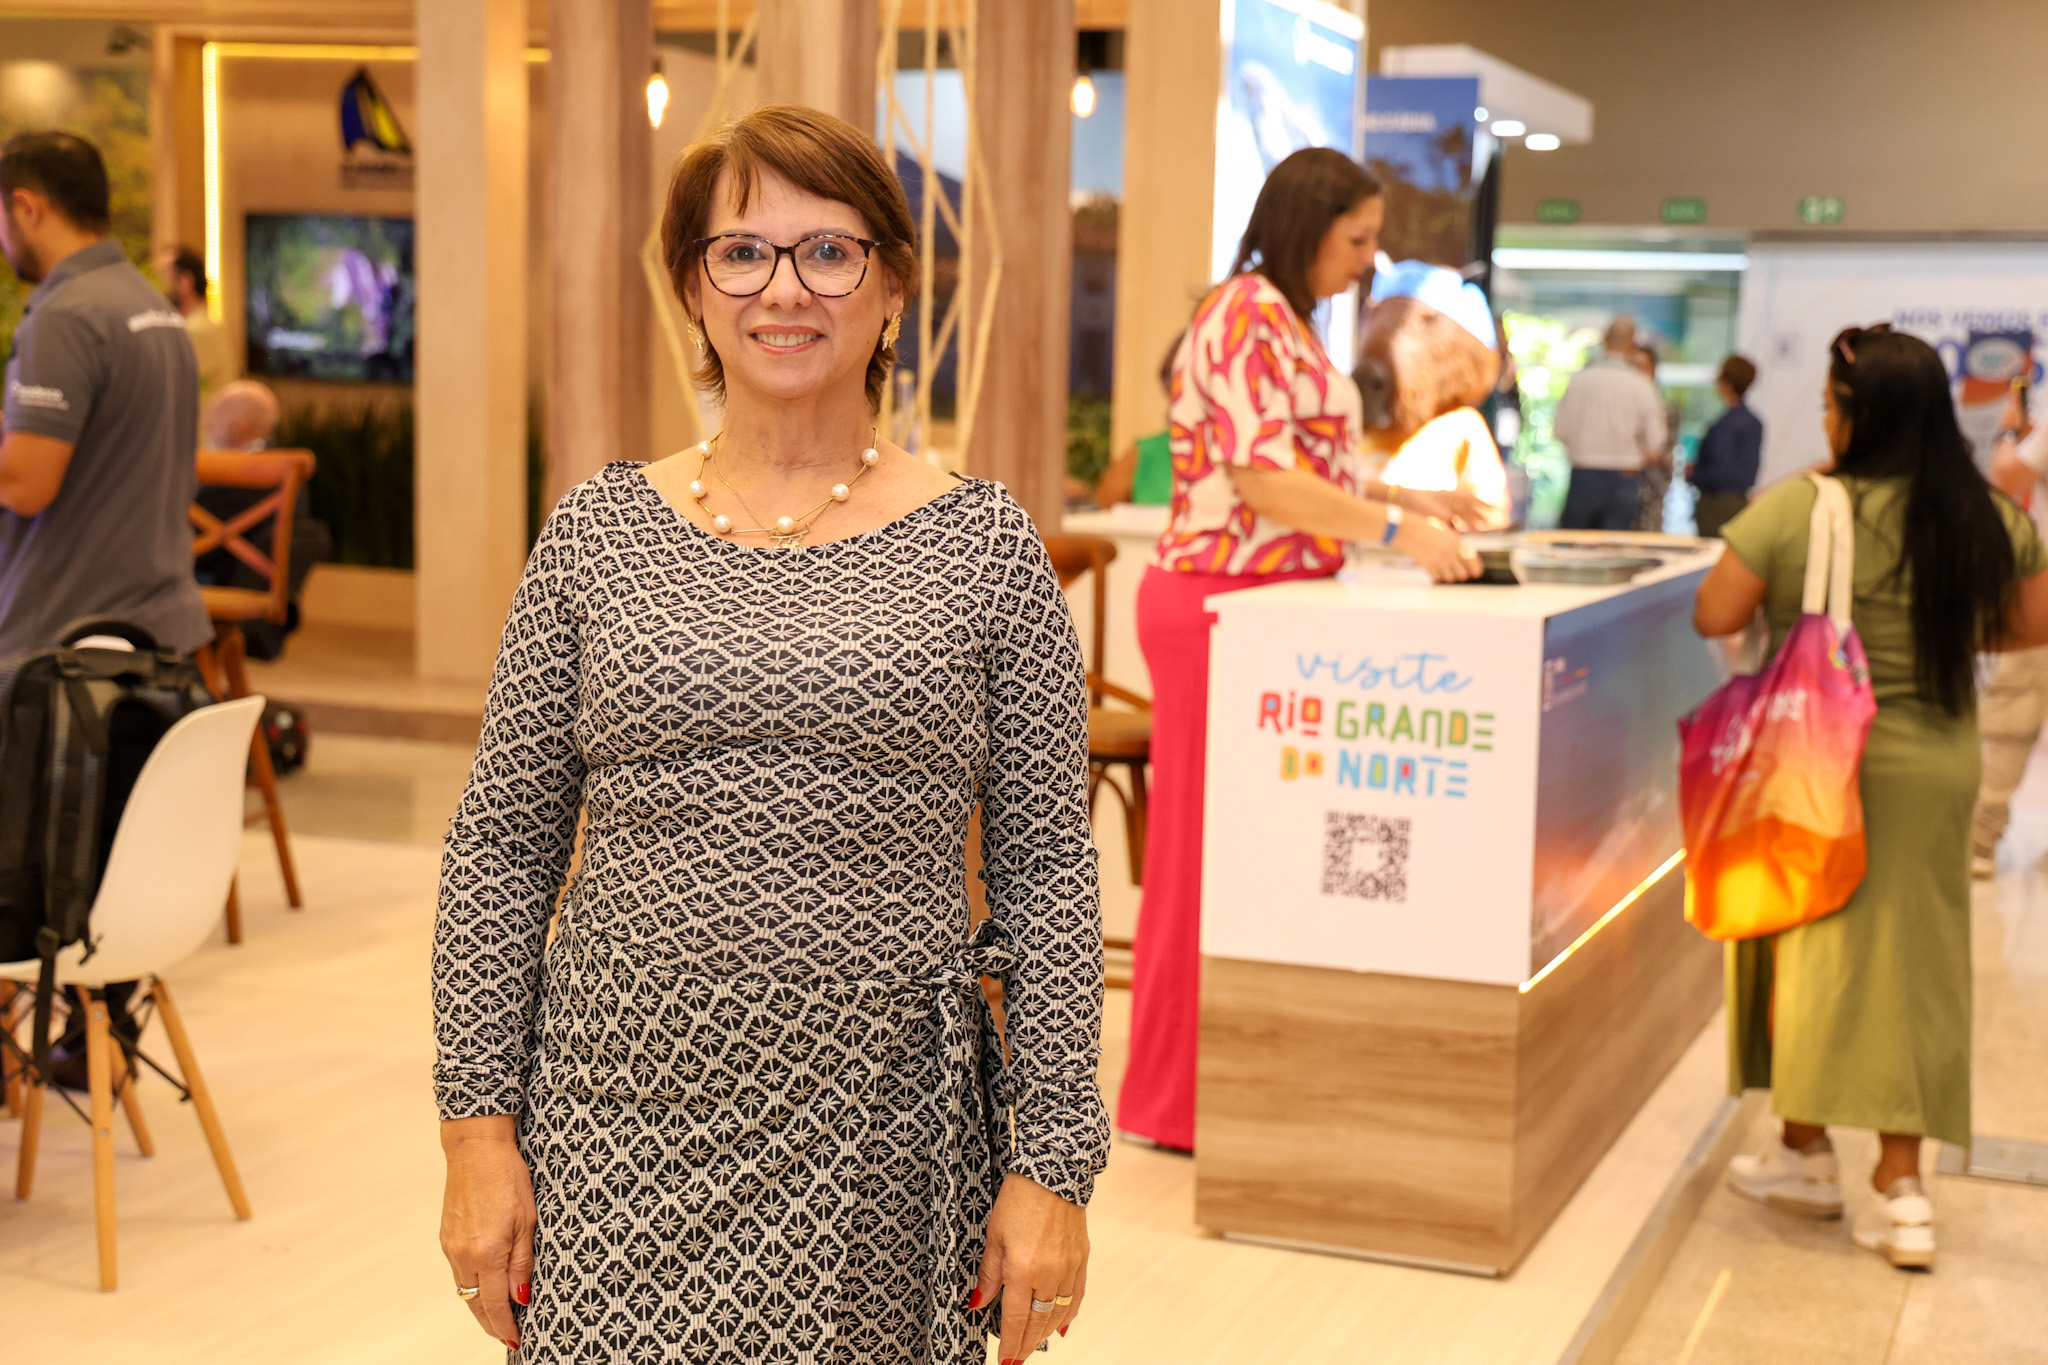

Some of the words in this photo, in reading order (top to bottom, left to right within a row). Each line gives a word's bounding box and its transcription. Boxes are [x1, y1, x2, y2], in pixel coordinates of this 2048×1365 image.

[1296, 652, 1473, 694] visite
[1335, 700, 1495, 751] GRANDE
[1337, 748, 1467, 798] NORTE
